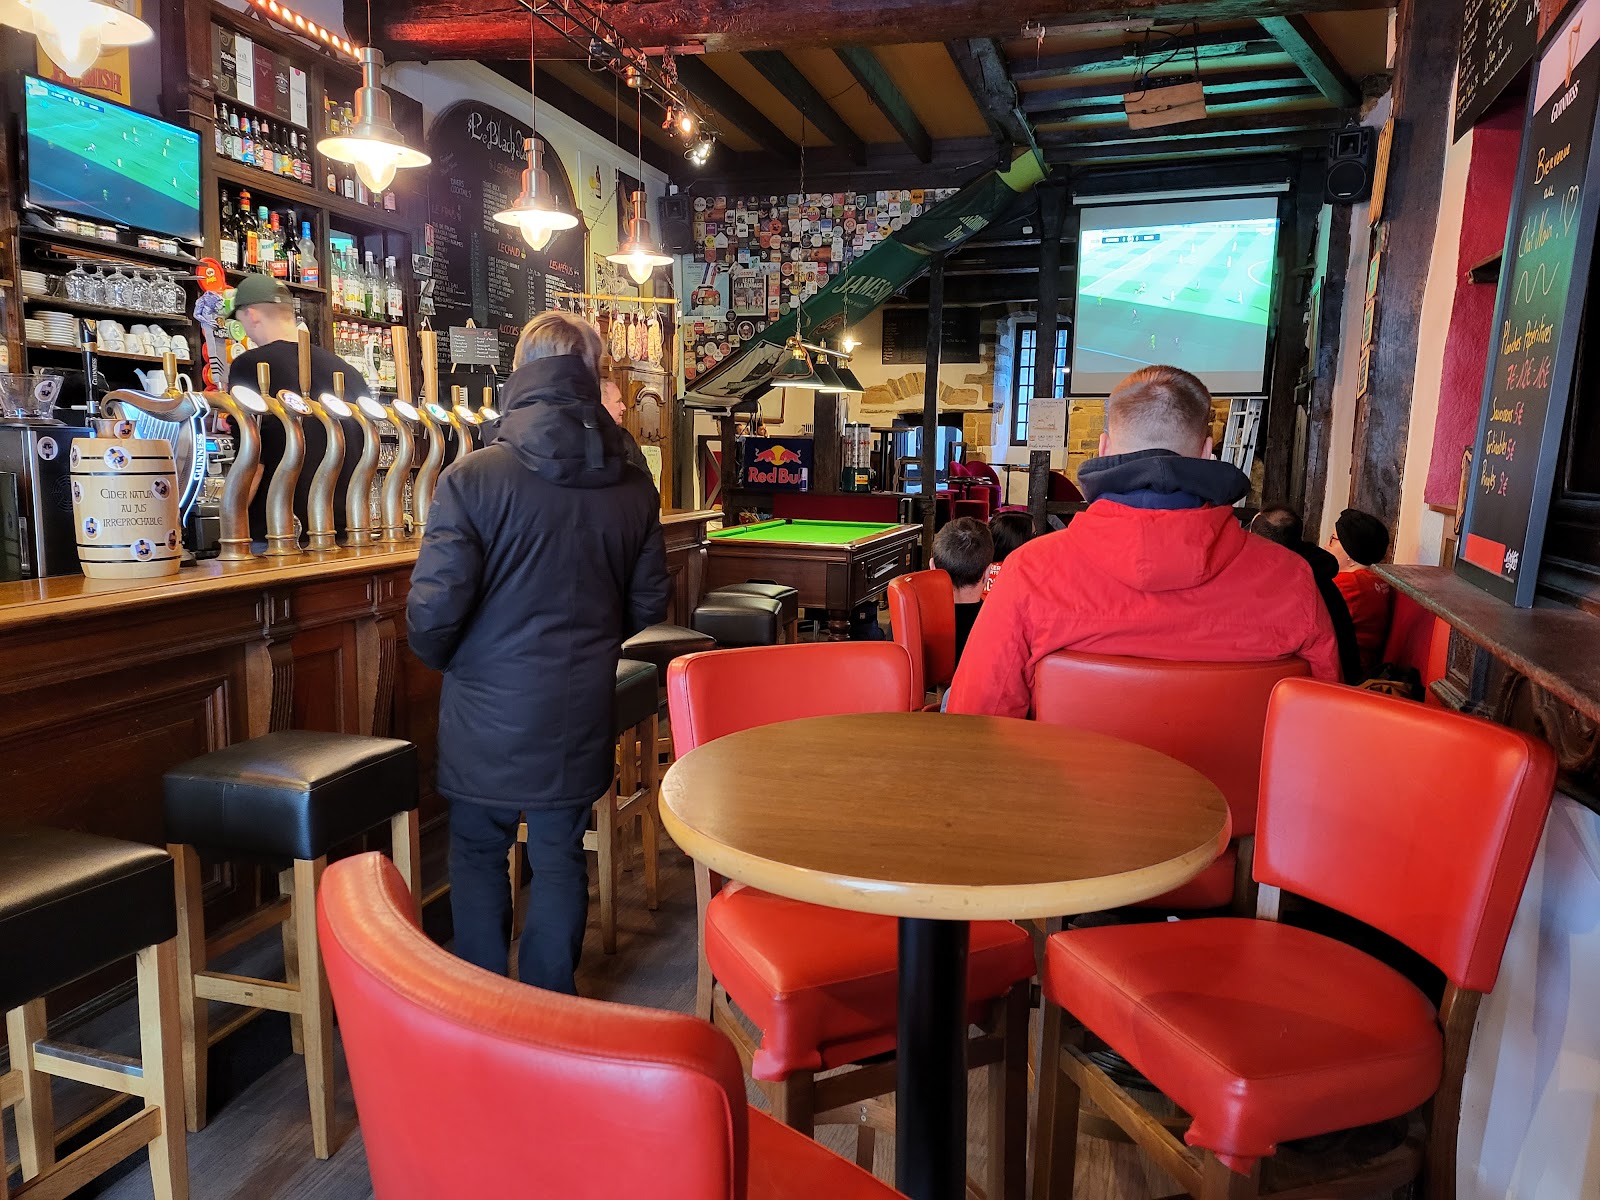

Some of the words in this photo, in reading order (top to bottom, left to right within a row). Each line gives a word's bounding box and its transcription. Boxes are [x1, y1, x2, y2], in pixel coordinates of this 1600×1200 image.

[1551, 79, 1580, 124] GUINNESS
[1534, 142, 1571, 185] Bienvenue
[1543, 184, 1555, 199] au
[832, 275, 893, 305] JAMESO
[1513, 401, 1525, 426] 5€
[193, 433, 203, 480] GUINNESS
[1505, 438, 1517, 461] 5€
[748, 467, 778, 483] Red
[778, 467, 801, 484] Bu
[1497, 471, 1509, 496] 2€
[129, 488, 154, 499] NATUR
[121, 504, 132, 513] AU
[134, 503, 147, 513] JUS
[103, 517, 163, 527] IRREPROCHABLE
